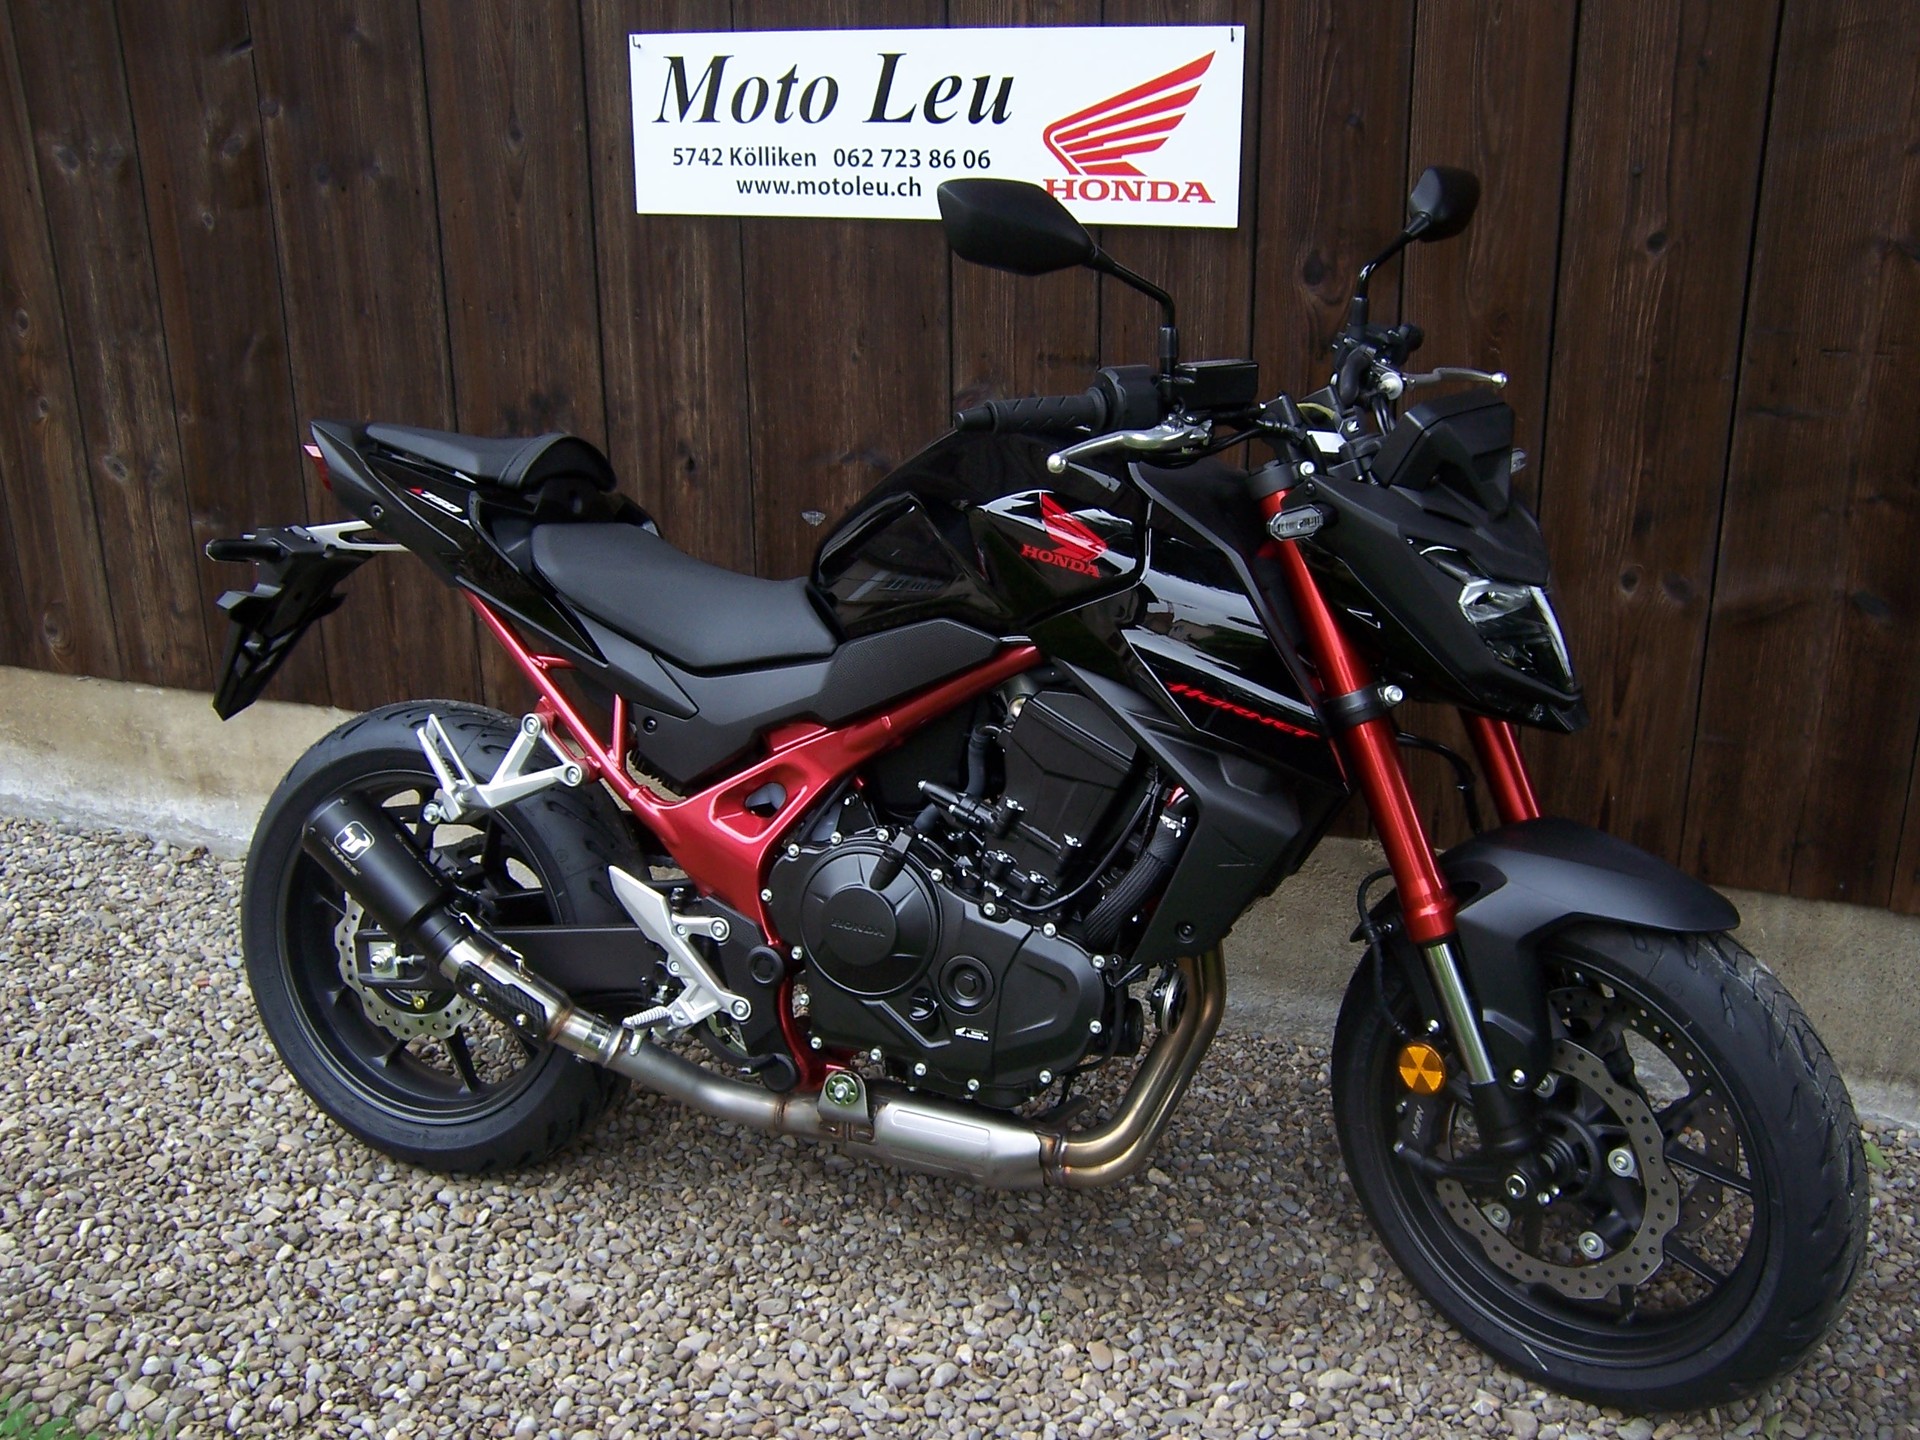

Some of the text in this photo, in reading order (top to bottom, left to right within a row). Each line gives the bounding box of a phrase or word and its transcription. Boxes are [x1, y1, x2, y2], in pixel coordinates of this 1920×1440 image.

[652, 53, 1014, 124] Moto Leu
[673, 146, 991, 169] 5742 Kölliken 062 723 86 06
[736, 175, 922, 197] www.motoleu.ch
[1043, 179, 1216, 204] HONDA
[1021, 543, 1102, 578] HONDA
[830, 917, 886, 938] HONDA
